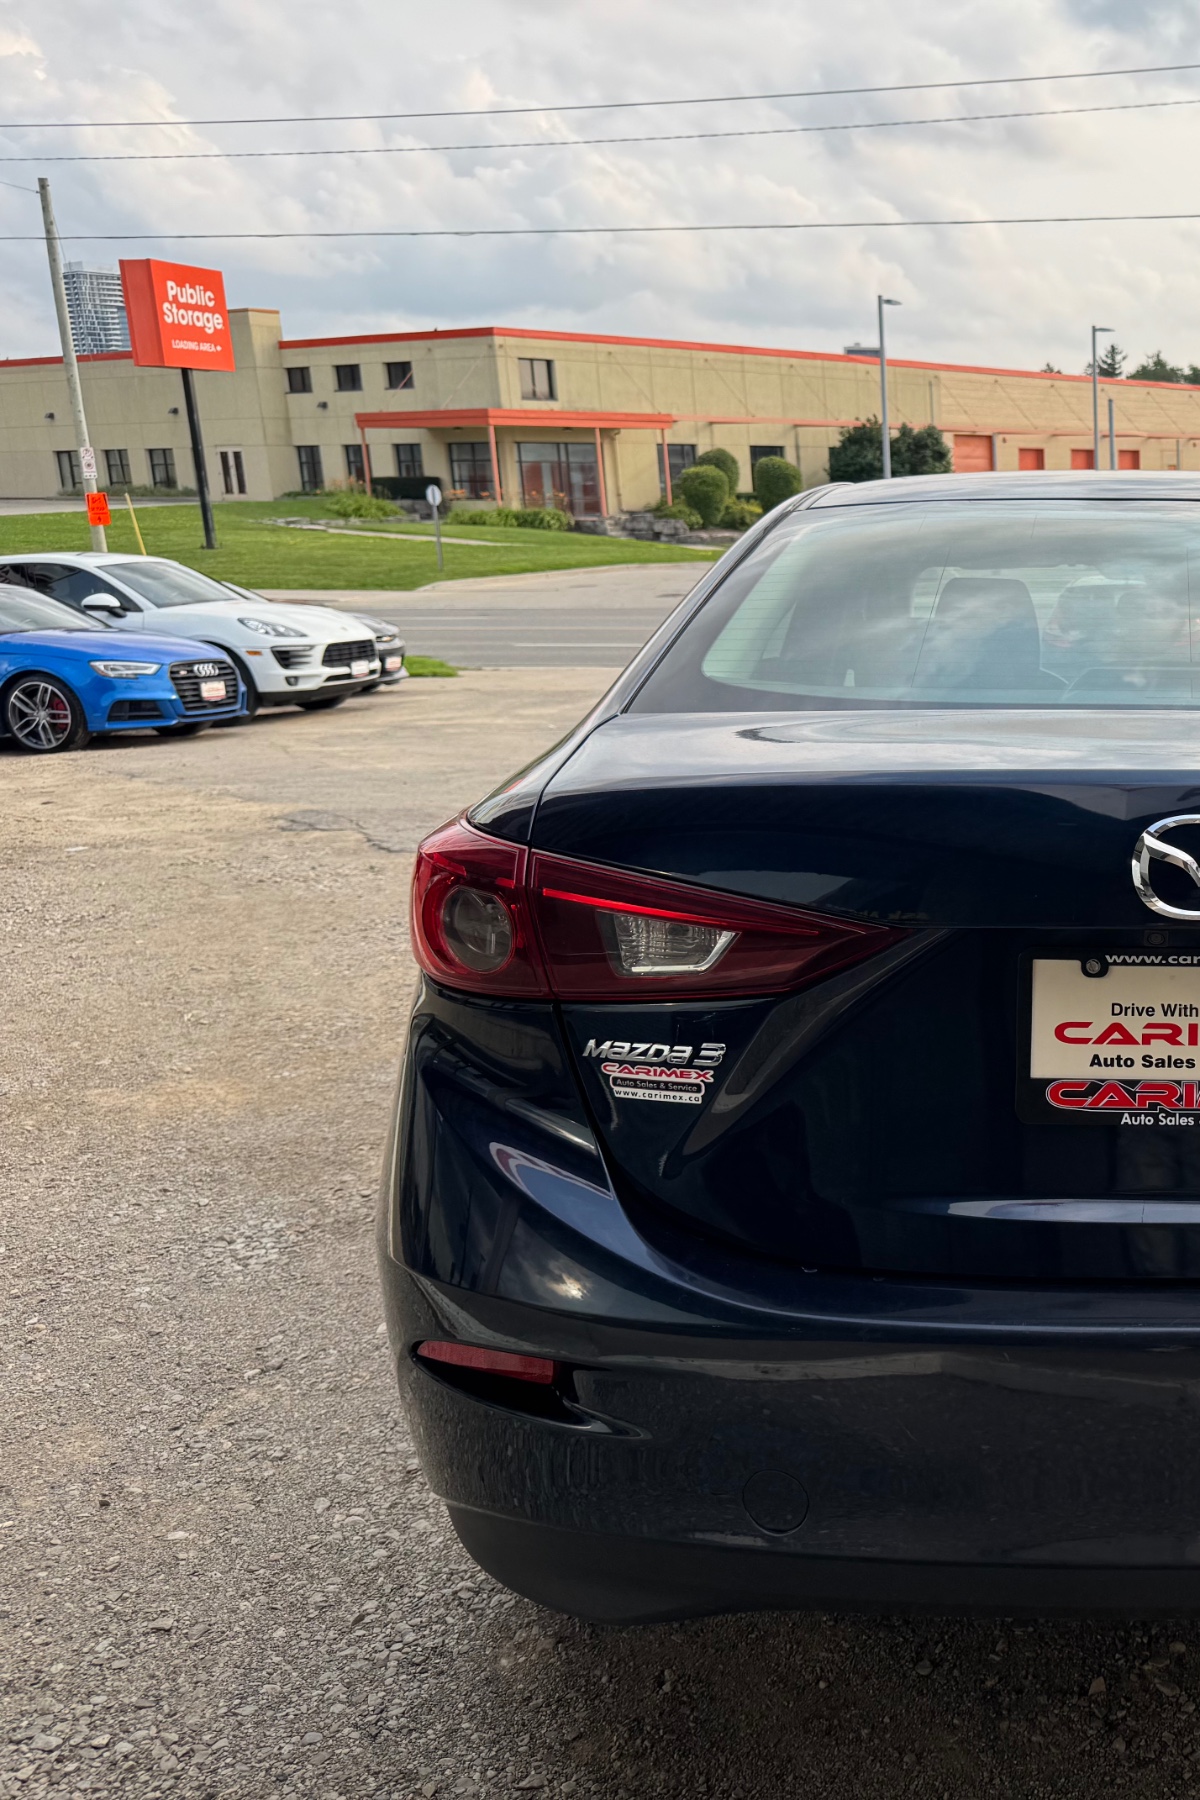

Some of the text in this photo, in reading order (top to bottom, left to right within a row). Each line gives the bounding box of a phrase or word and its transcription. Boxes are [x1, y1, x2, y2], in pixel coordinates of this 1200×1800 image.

[166, 280, 215, 307] Public
[162, 302, 223, 334] Storage
[172, 339, 216, 353] LOADING AREA
[1111, 1003, 1156, 1017] Drive
[1161, 1003, 1199, 1018] With
[692, 1043, 727, 1067] 3
[1089, 1054, 1135, 1068] Auto
[1141, 1054, 1196, 1069] Sales
[602, 1063, 713, 1081] CARIMEX
[616, 1078, 635, 1087] Auto
[636, 1080, 658, 1089] Sales
[668, 1082, 698, 1092] Service
[614, 1089, 700, 1102] www.carimex.ca
[1121, 1113, 1154, 1126] Auto
[1158, 1113, 1194, 1126] Sales
